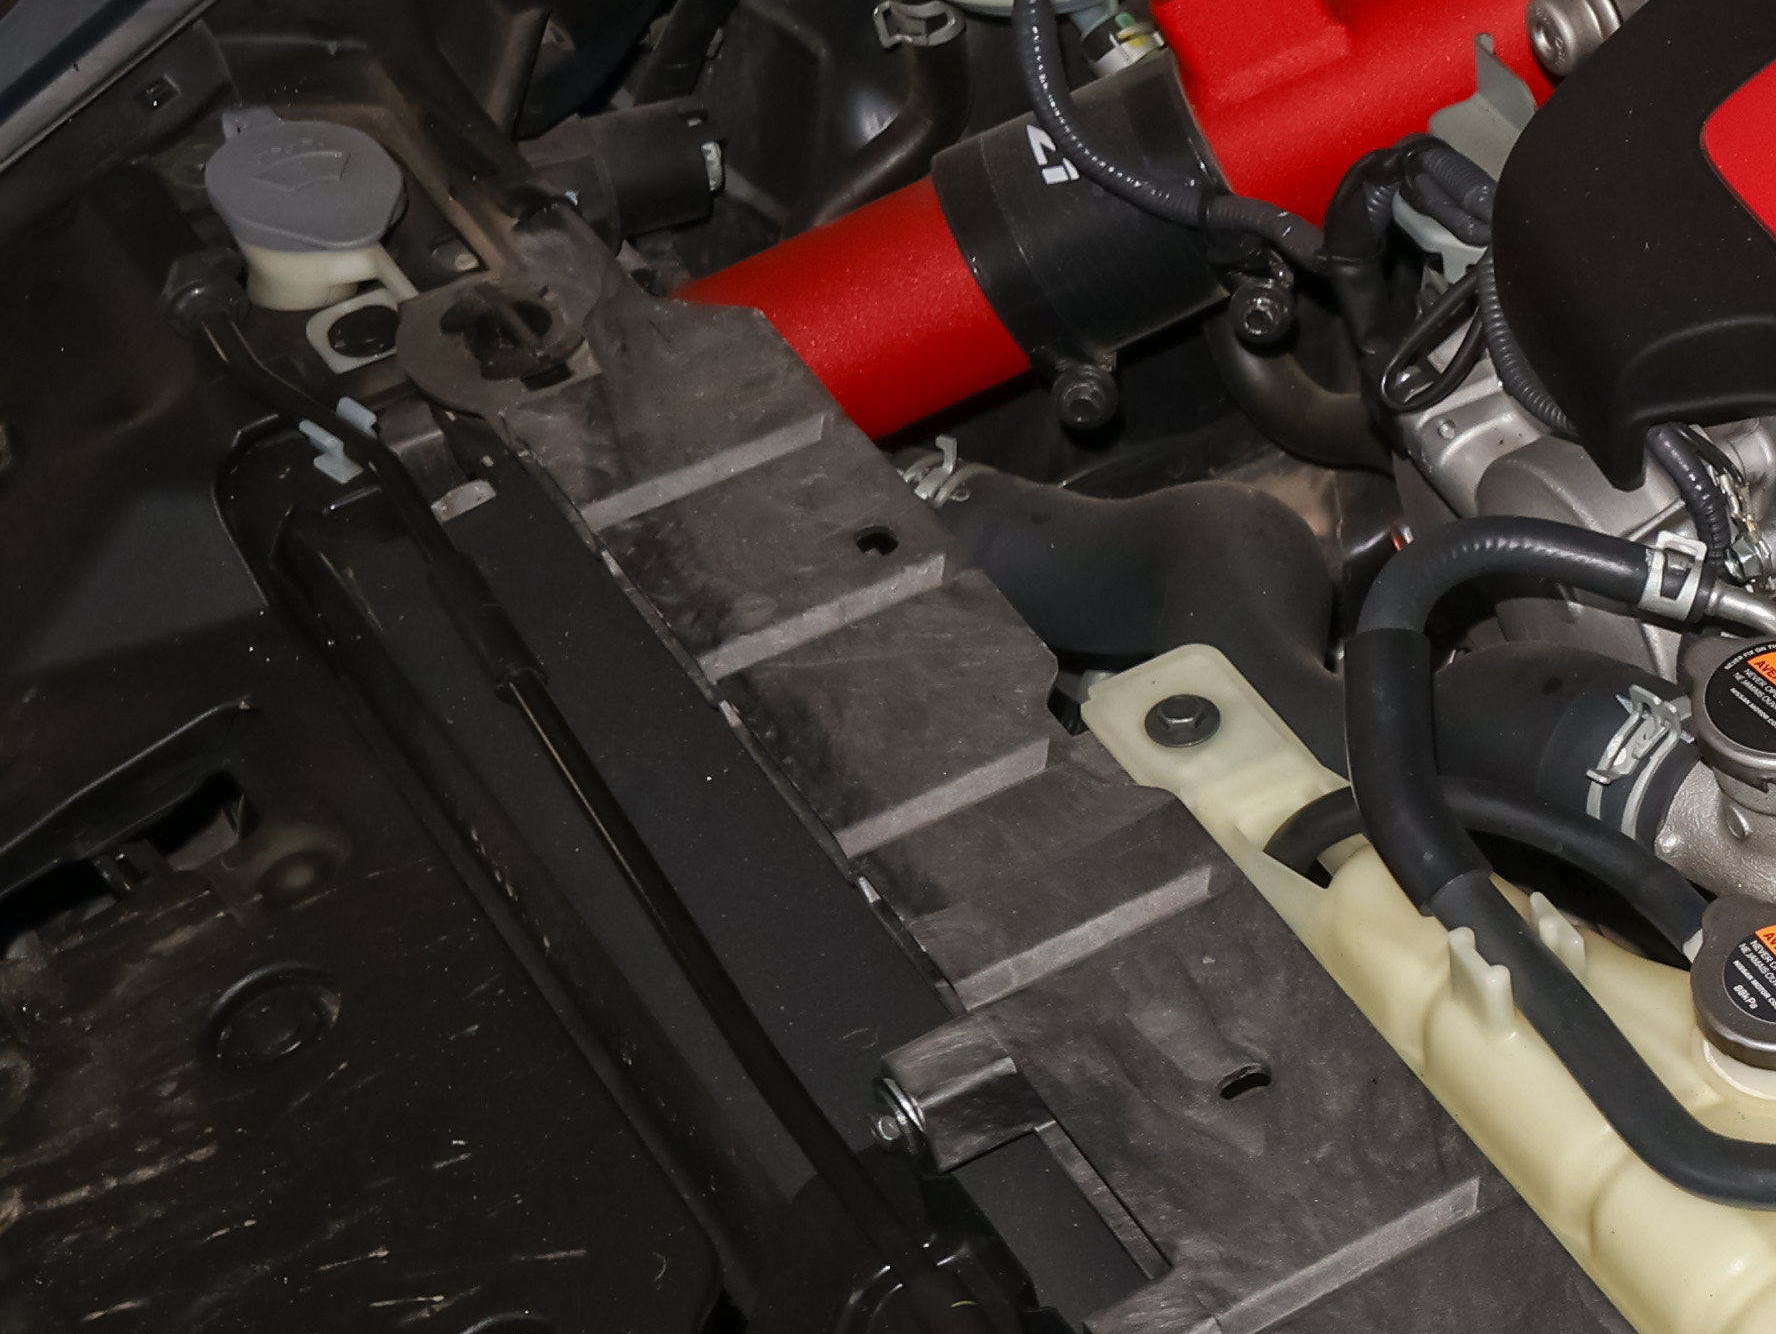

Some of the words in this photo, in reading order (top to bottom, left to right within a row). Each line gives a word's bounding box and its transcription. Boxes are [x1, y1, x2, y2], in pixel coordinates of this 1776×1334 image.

[1743, 667, 1766, 687] NEVER
[1729, 686, 1749, 704] NISSAN
[1748, 701, 1769, 720] MOTOR
[1738, 943, 1749, 954] NE
[1745, 951, 1768, 974] JAMAIS
[1750, 940, 1773, 962] NEVER
[1733, 983, 1758, 1010] 88kPa
[1750, 979, 1770, 999] MOTOR
